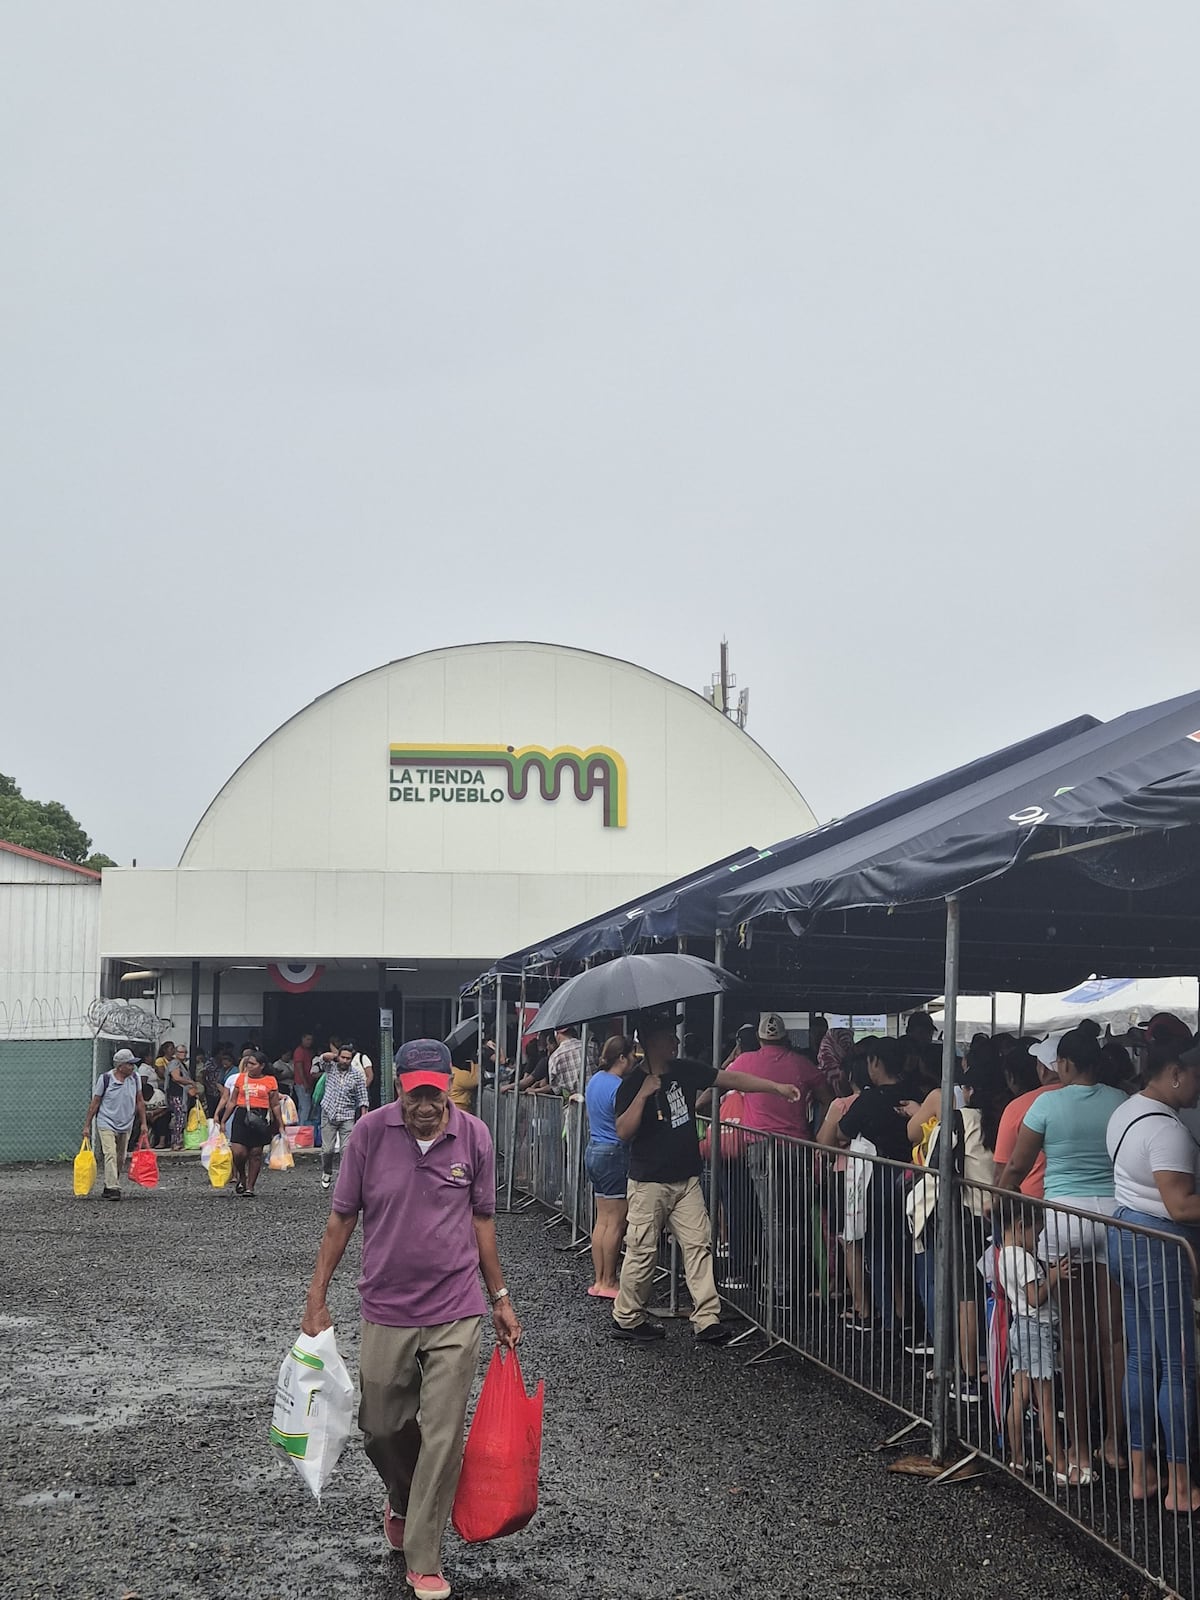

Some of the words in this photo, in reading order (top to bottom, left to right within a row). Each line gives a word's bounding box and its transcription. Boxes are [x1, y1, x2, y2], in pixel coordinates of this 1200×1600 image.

[389, 768, 413, 784] LA
[416, 769, 486, 785] TIENDA
[389, 787, 425, 802] DEL
[429, 787, 505, 804] PUEBLO
